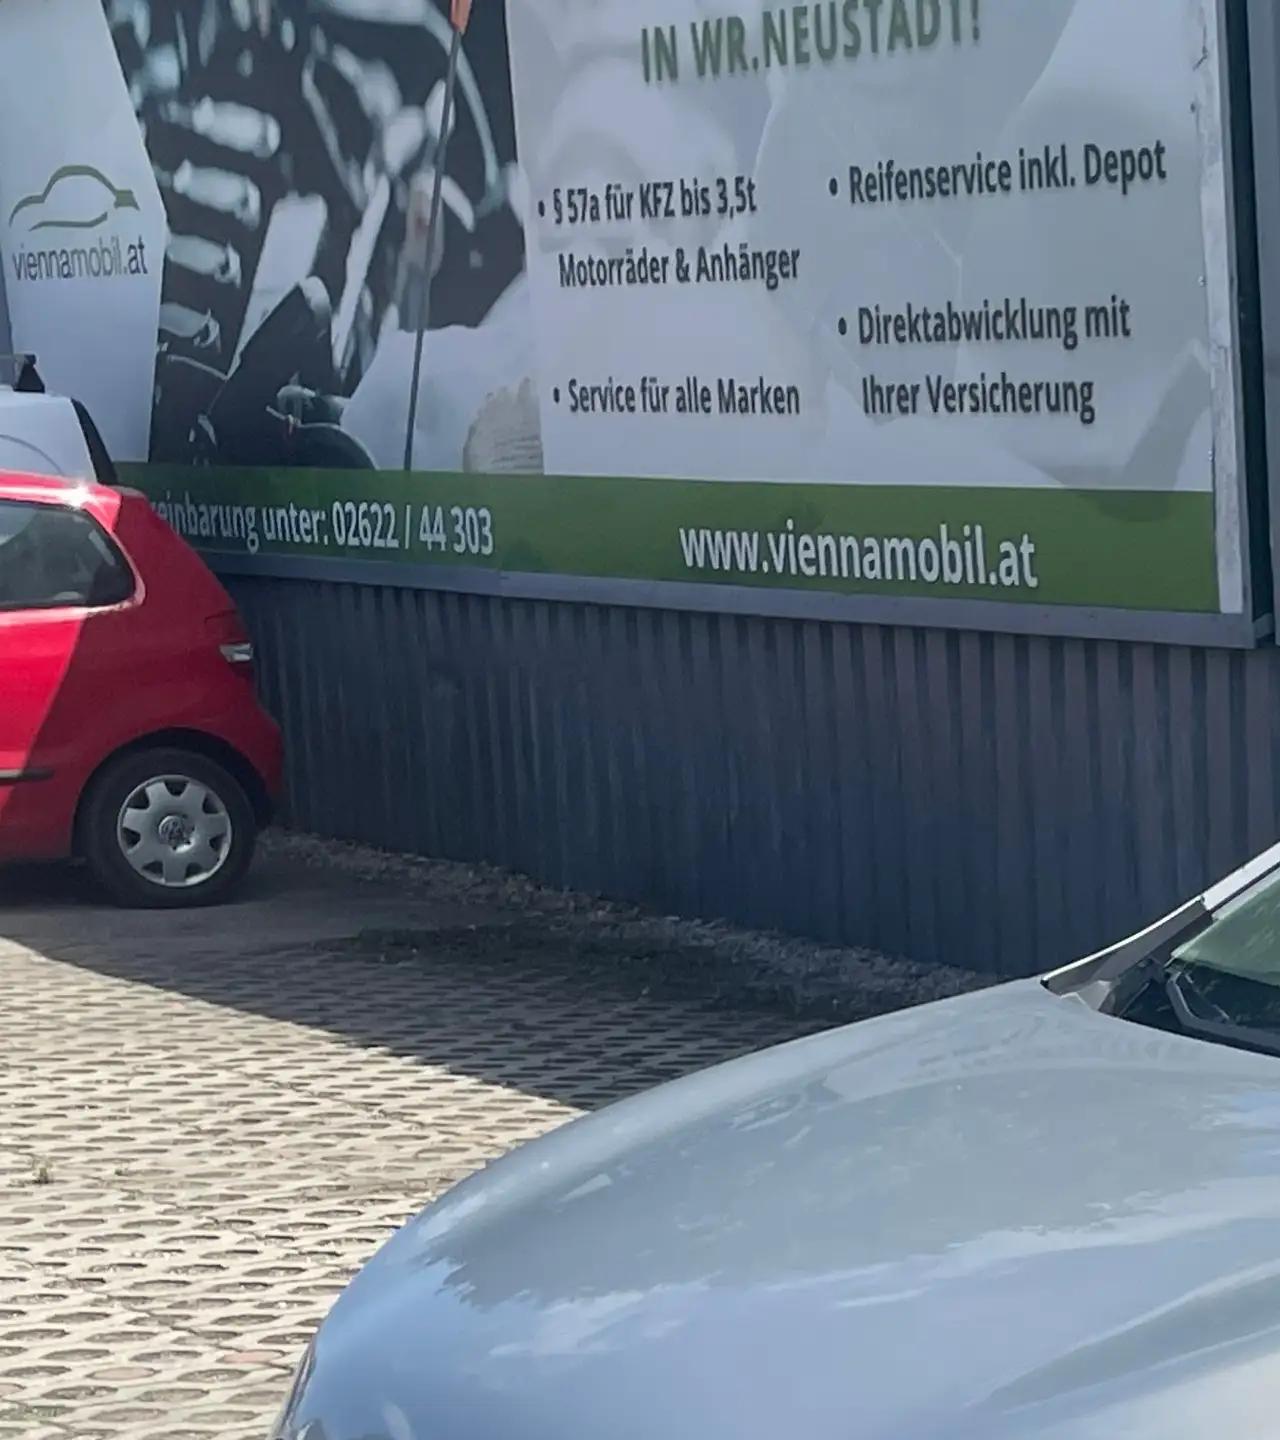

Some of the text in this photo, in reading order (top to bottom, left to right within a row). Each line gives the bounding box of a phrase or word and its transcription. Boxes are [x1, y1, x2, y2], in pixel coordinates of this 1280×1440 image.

[641, 24, 679, 84] IN
[552, 175, 758, 225] § 57a für KFZ bis 3,5t
[848, 139, 1168, 205] Reifenservice inkl. Depot
[12, 234, 149, 282] viennamobil.at
[557, 242, 801, 291] Motorräder & Anhänger
[857, 293, 1132, 351] Direktabwicklung mit
[567, 375, 801, 415] Service für alle Marken
[861, 370, 1096, 425] Ihrer Versicherung
[260, 501, 330, 548] unter:
[331, 500, 400, 550] 02622
[403, 504, 413, 551] /
[418, 503, 447, 554] 44
[452, 505, 495, 557] 303
[678, 517, 1040, 588] www.viennamobil.at
